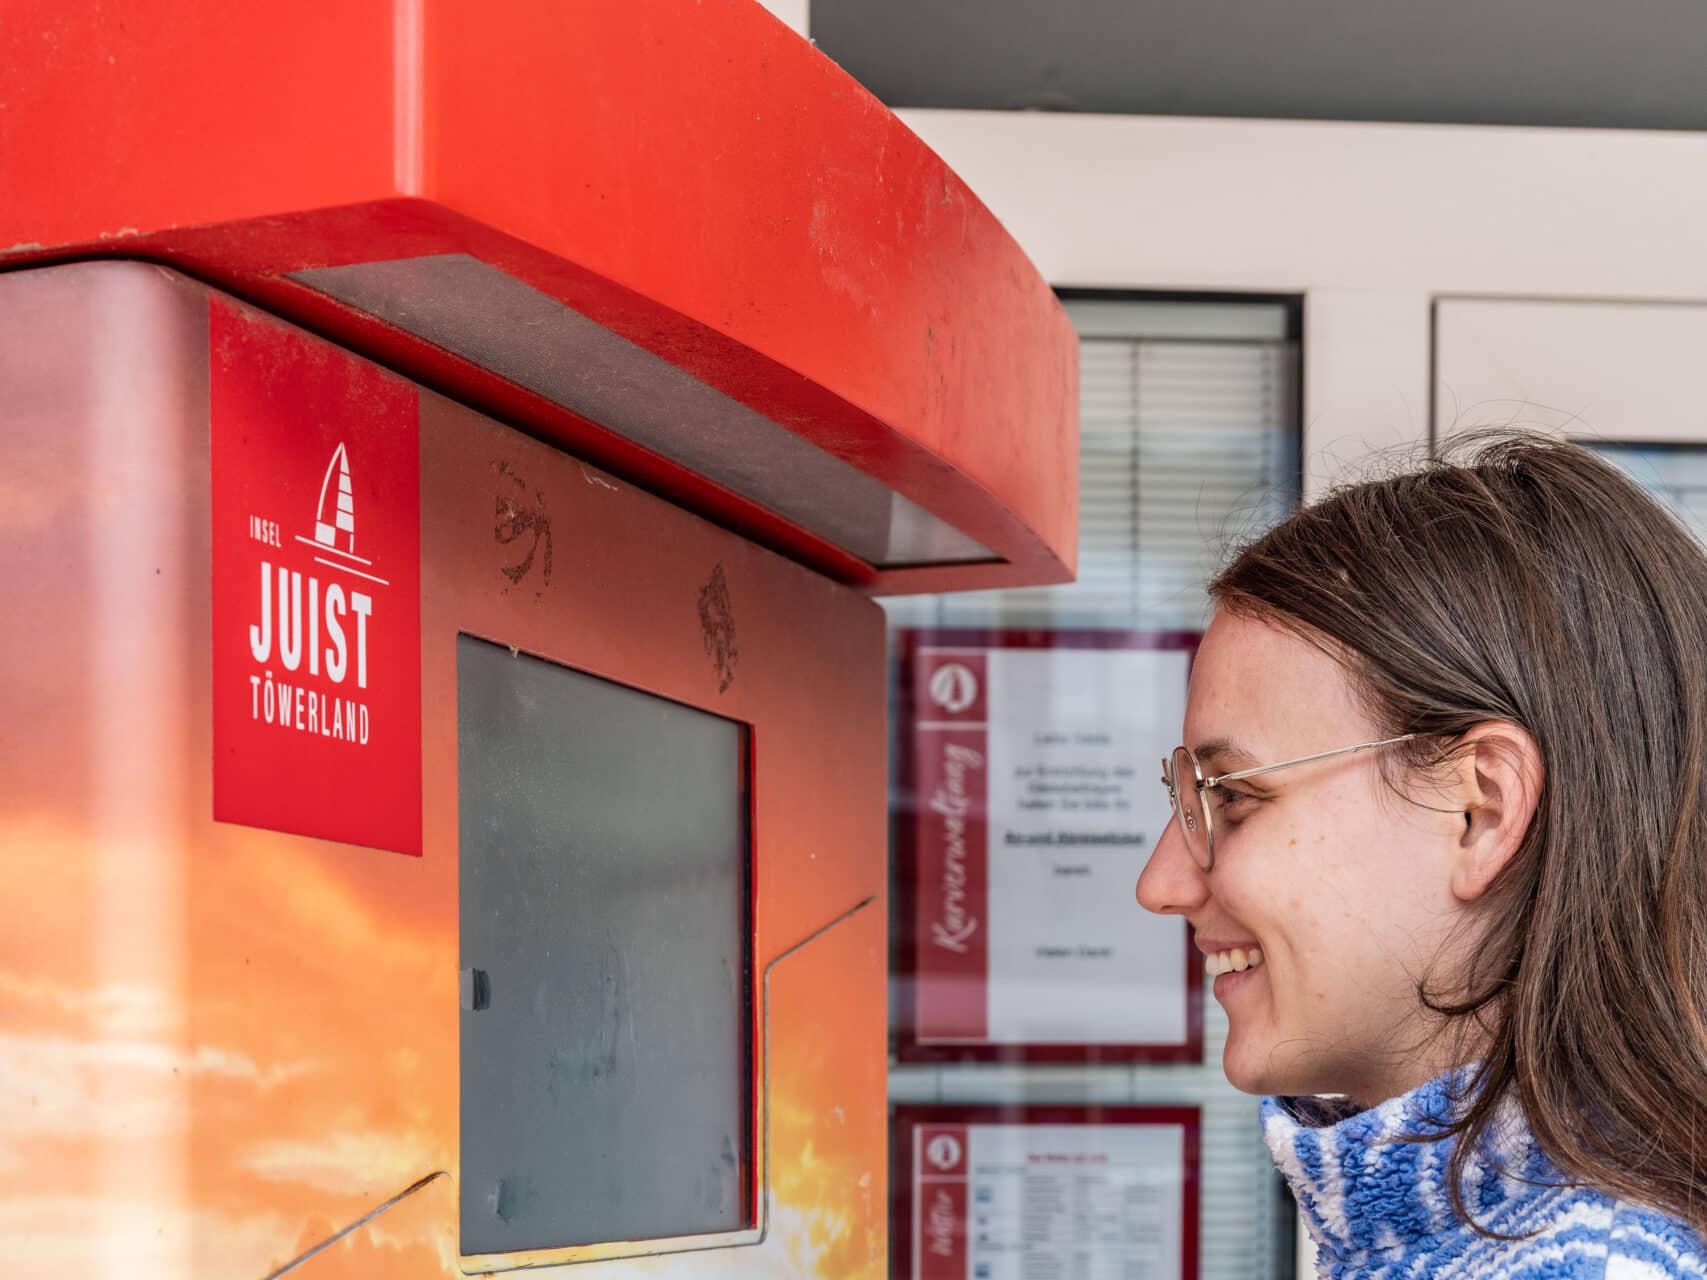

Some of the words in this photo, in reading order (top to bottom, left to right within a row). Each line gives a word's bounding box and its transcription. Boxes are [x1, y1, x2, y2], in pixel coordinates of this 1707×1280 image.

[250, 515, 281, 548] INSEL
[250, 561, 372, 689] JUIST
[250, 671, 369, 745] TÖWERLAND
